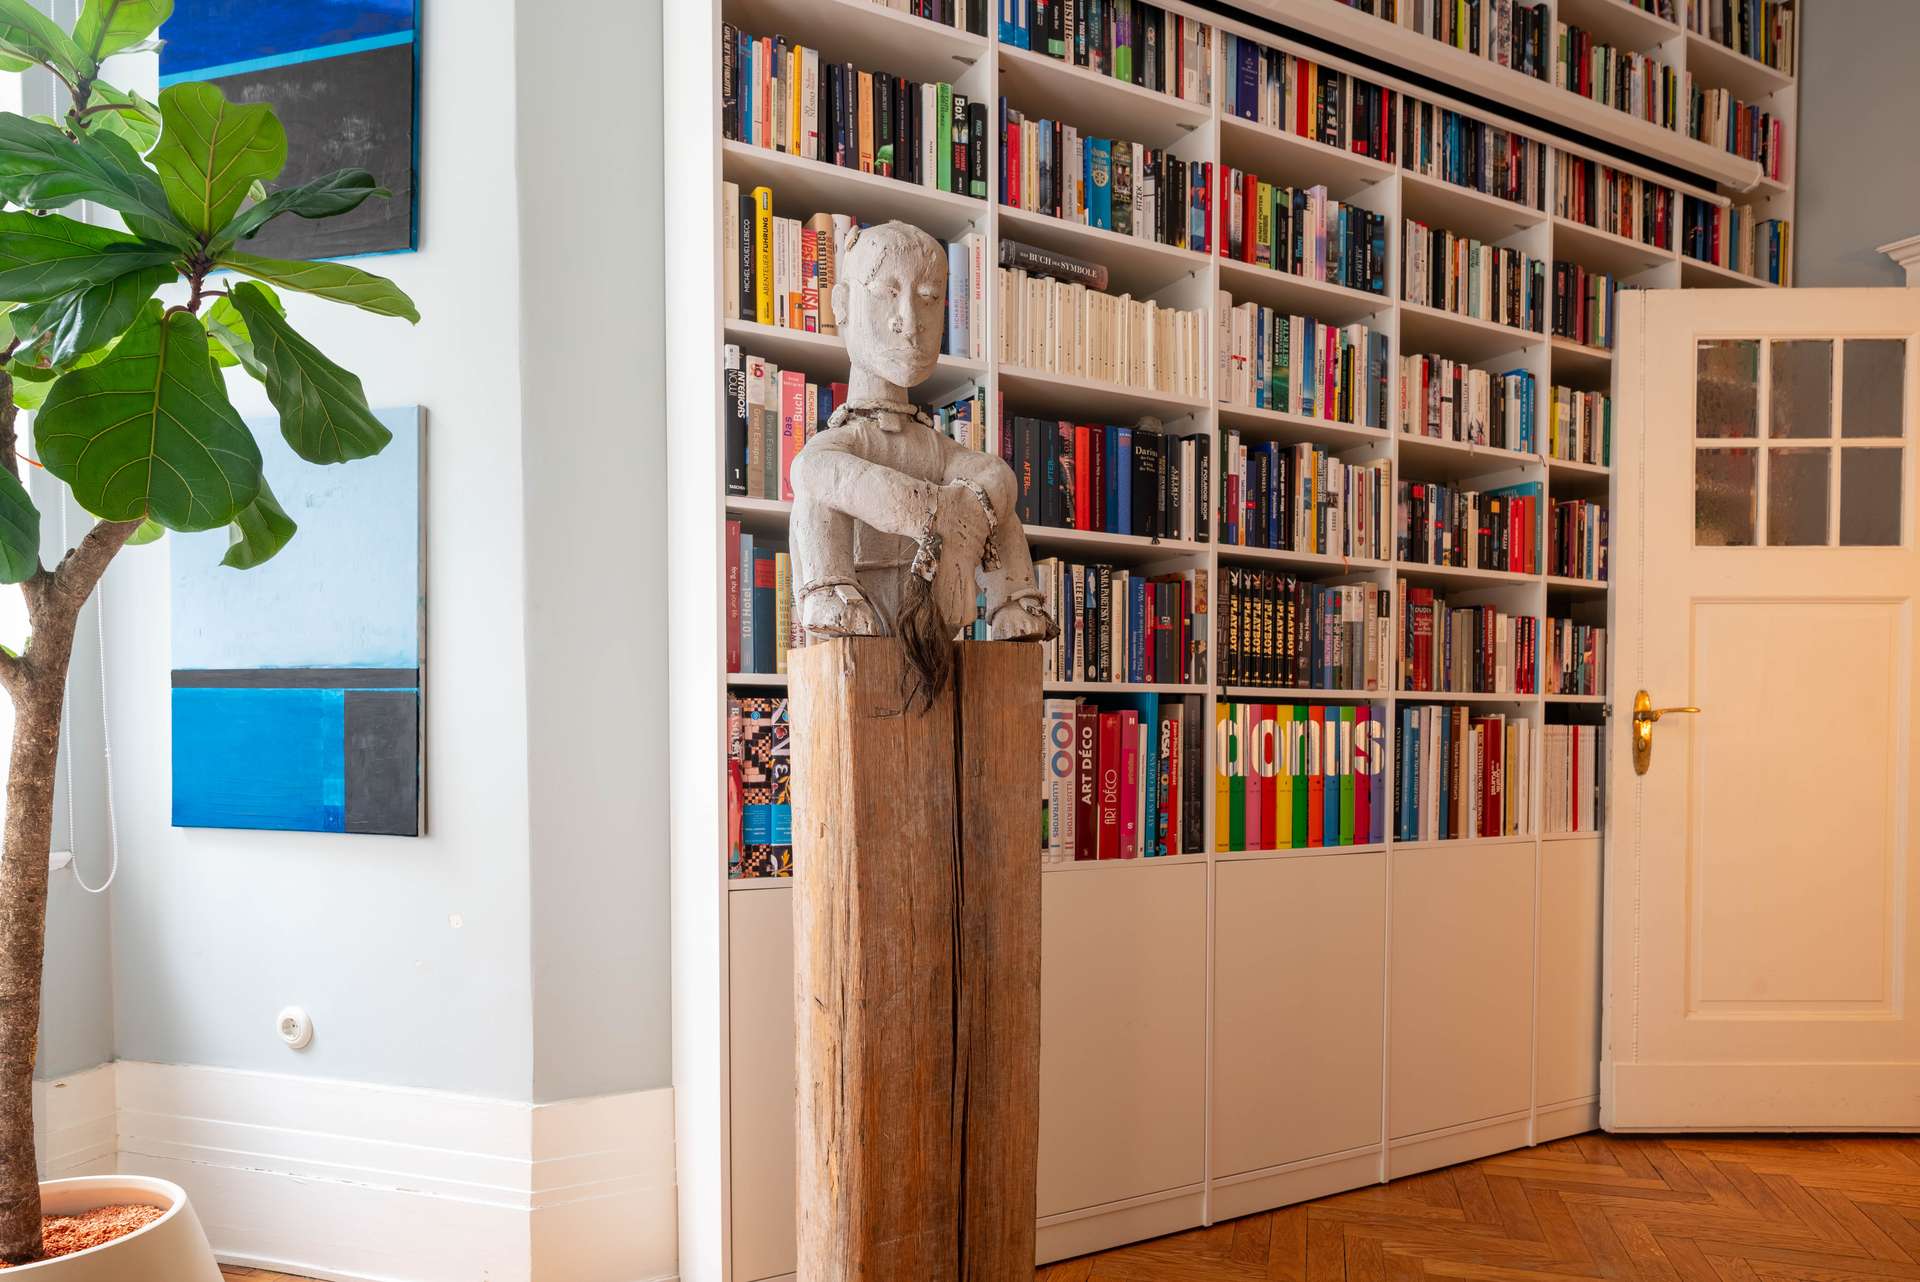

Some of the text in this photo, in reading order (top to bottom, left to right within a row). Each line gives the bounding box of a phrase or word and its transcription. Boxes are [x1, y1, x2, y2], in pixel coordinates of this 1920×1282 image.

[1029, 252, 1052, 265] BUCH
[1060, 262, 1097, 278] SYMBOLE
[802, 288, 817, 310] USA
[737, 370, 745, 418] INTERIORS
[751, 408, 761, 465] Great Escapes
[783, 417, 792, 436] Das
[1023, 461, 1031, 486] AFTER
[1075, 581, 1083, 595] LEE
[1101, 569, 1109, 588] SARA
[743, 588, 751, 616] Hotel
[1075, 596, 1083, 617] CHILD
[1101, 588, 1109, 620] PARETSKY
[743, 620, 751, 638] 101
[1252, 602, 1260, 655] PLAYBOY
[1264, 602, 1272, 655] PLAYBOY
[1051, 712, 1073, 778] 100
[1161, 720, 1170, 759] CASA
[1079, 726, 1092, 805] ART DÉCO
[1103, 769, 1117, 824] ART DÉCO
